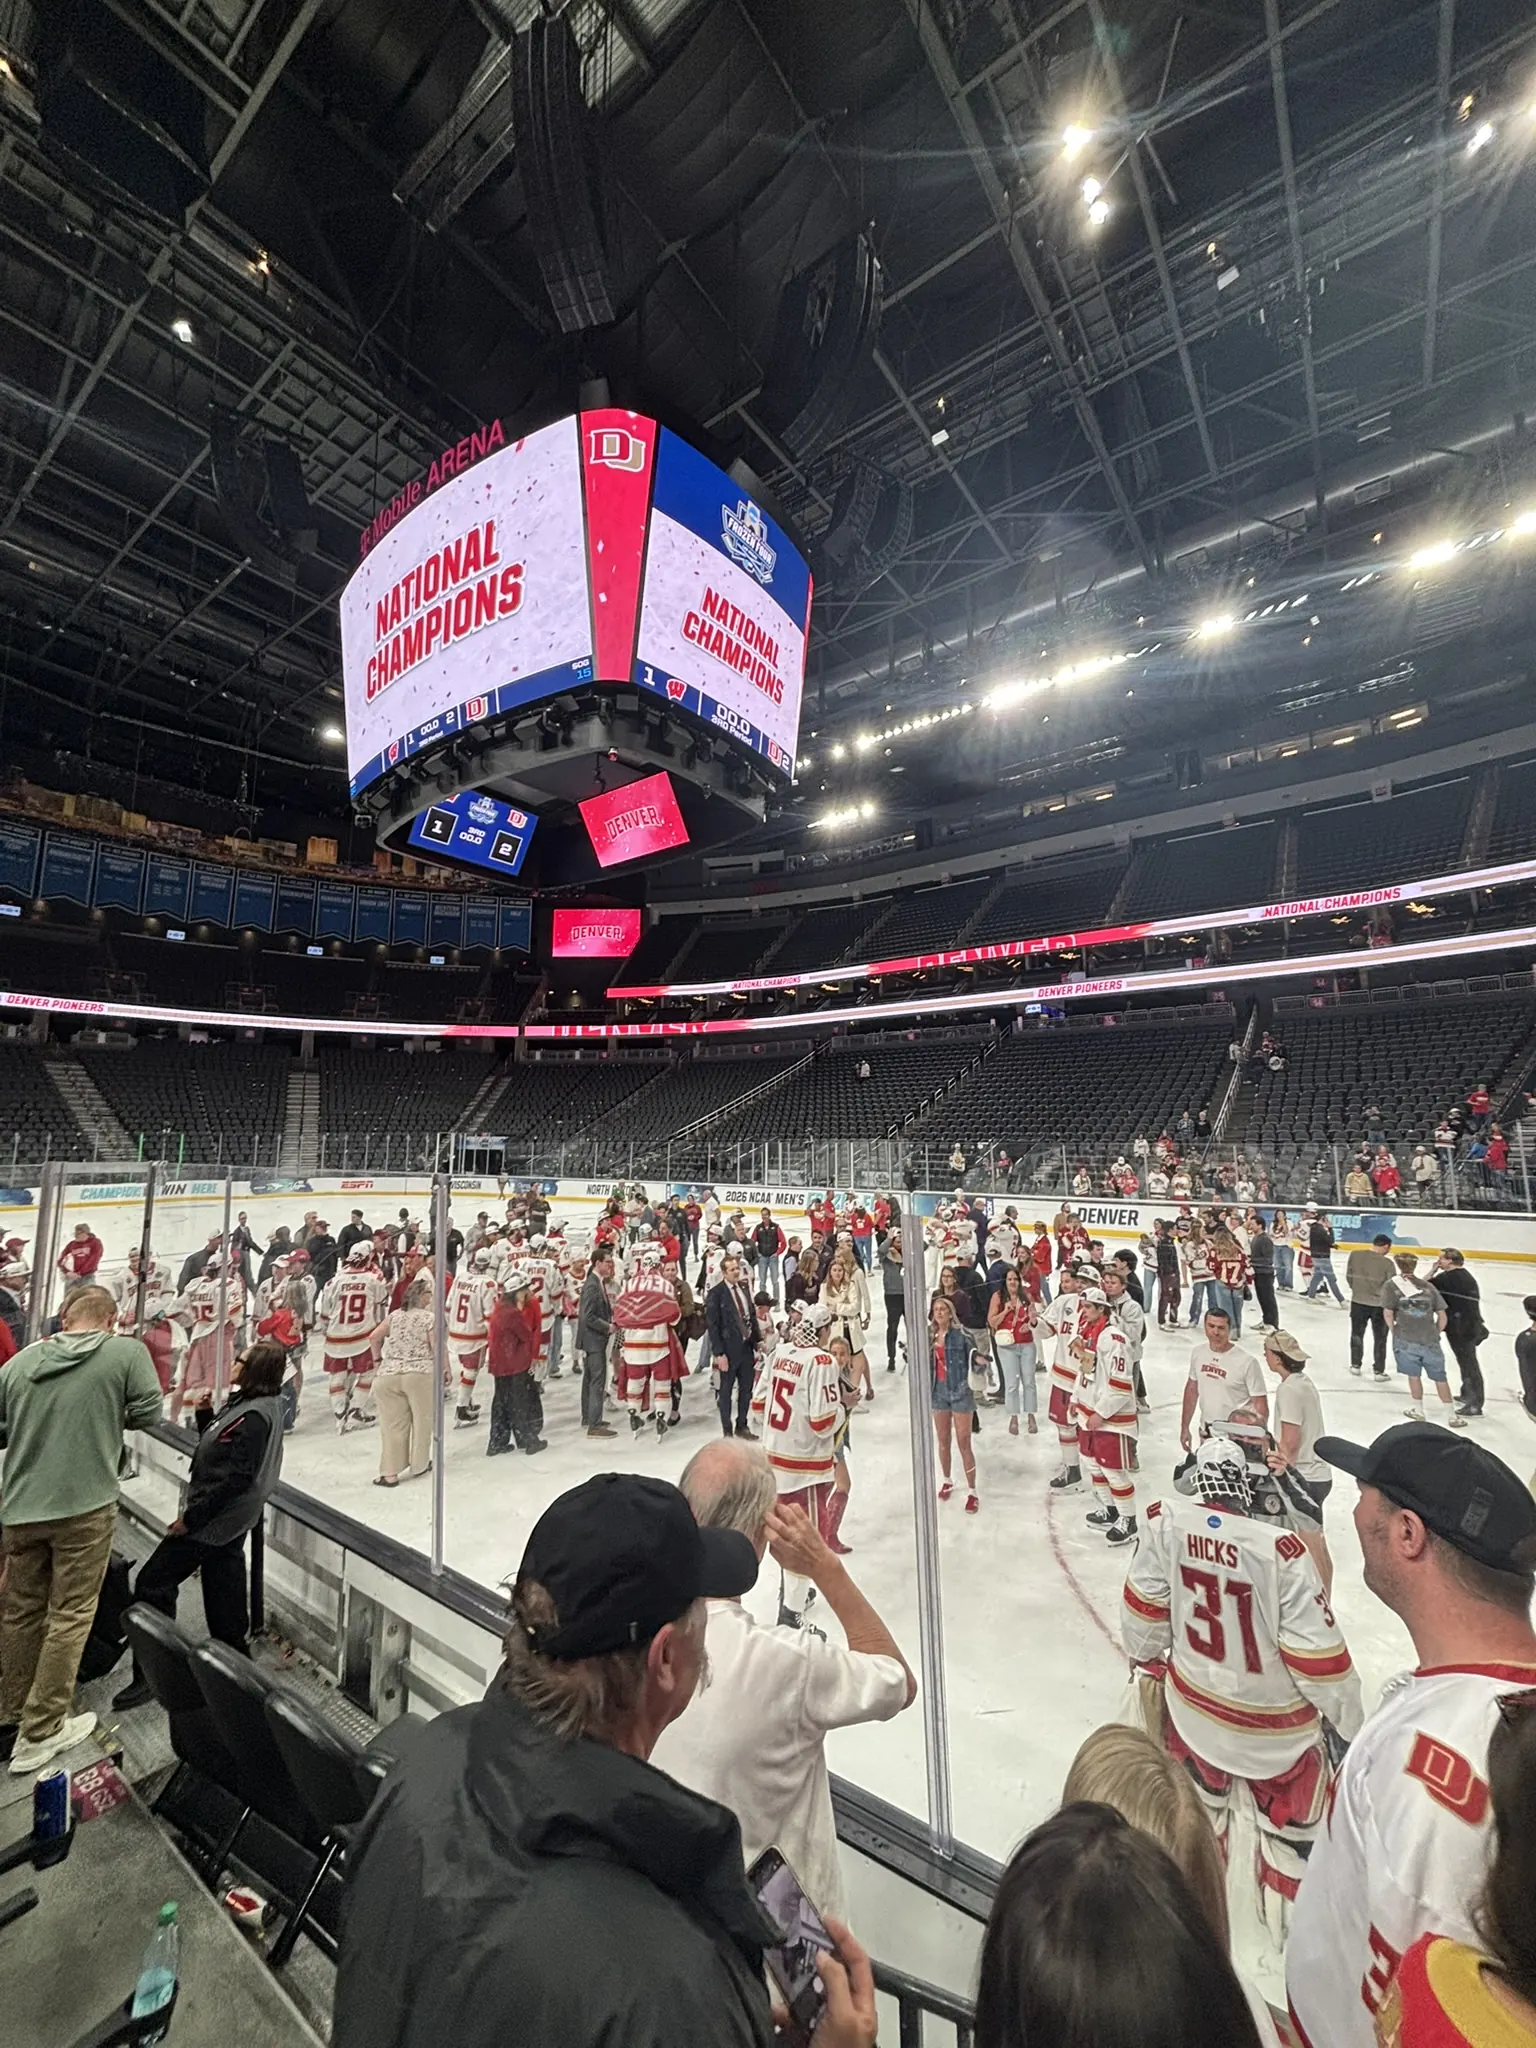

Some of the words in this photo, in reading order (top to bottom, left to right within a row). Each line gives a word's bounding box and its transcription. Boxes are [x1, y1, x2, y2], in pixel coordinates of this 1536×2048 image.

[426, 418, 505, 493] ARENA
[728, 517, 756, 549] FROZEN
[754, 540, 773, 565] FOUR
[375, 519, 501, 643] NATIONAL
[366, 561, 525, 700] CHAMPIONS
[702, 586, 779, 669] NATIONAL
[571, 659, 590, 671] SOG
[682, 612, 785, 704] CHAMPIONS
[576, 667, 592, 680] 15
[643, 666, 656, 687] 1
[408, 733, 415, 745] 1
[446, 711, 455, 724] 2
[716, 703, 751, 735] 00.0
[728, 725, 753, 746] Period
[781, 754, 790, 771] 2
[606, 806, 661, 840] DENVER
[431, 820, 442, 834] 1
[467, 826, 486, 837] 3RD
[498, 842, 513, 856] 2
[1262, 900, 1323, 918] NATIONAL
[1324, 887, 1401, 910] CHAMPIONS
[571, 926, 622, 941] DENVER
[731, 980, 762, 990] NATIONAL
[763, 976, 801, 986] CHAMPIONS
[1038, 985, 1073, 998] DENVER
[1075, 980, 1123, 996] PIONEERS
[7, 994, 50, 1007] DENVER
[51, 999, 105, 1012] PIONEERS
[80, 1186, 147, 1200] CHAMPION
[160, 1183, 187, 1196] WIN
[190, 1183, 217, 1194] HERE
[340, 1180, 374, 1189] ESPN
[586, 1184, 610, 1196] NORTH
[725, 1190, 747, 1203] 2026
[775, 1193, 805, 1206] MEN'S
[1077, 1206, 1139, 1226] DENVER
[1220, 1261, 1241, 1284] 17
[341, 1282, 366, 1292] FISHER
[339, 1293, 367, 1325] 19
[456, 1294, 471, 1323] 6
[773, 1357, 804, 1377] JAMESON
[1201, 1364, 1227, 1379] DENVER
[822, 1383, 838, 1403] 15
[768, 1376, 797, 1432] 15
[1187, 1533, 1238, 1569] HICKS
[1180, 1564, 1264, 1675] 31
